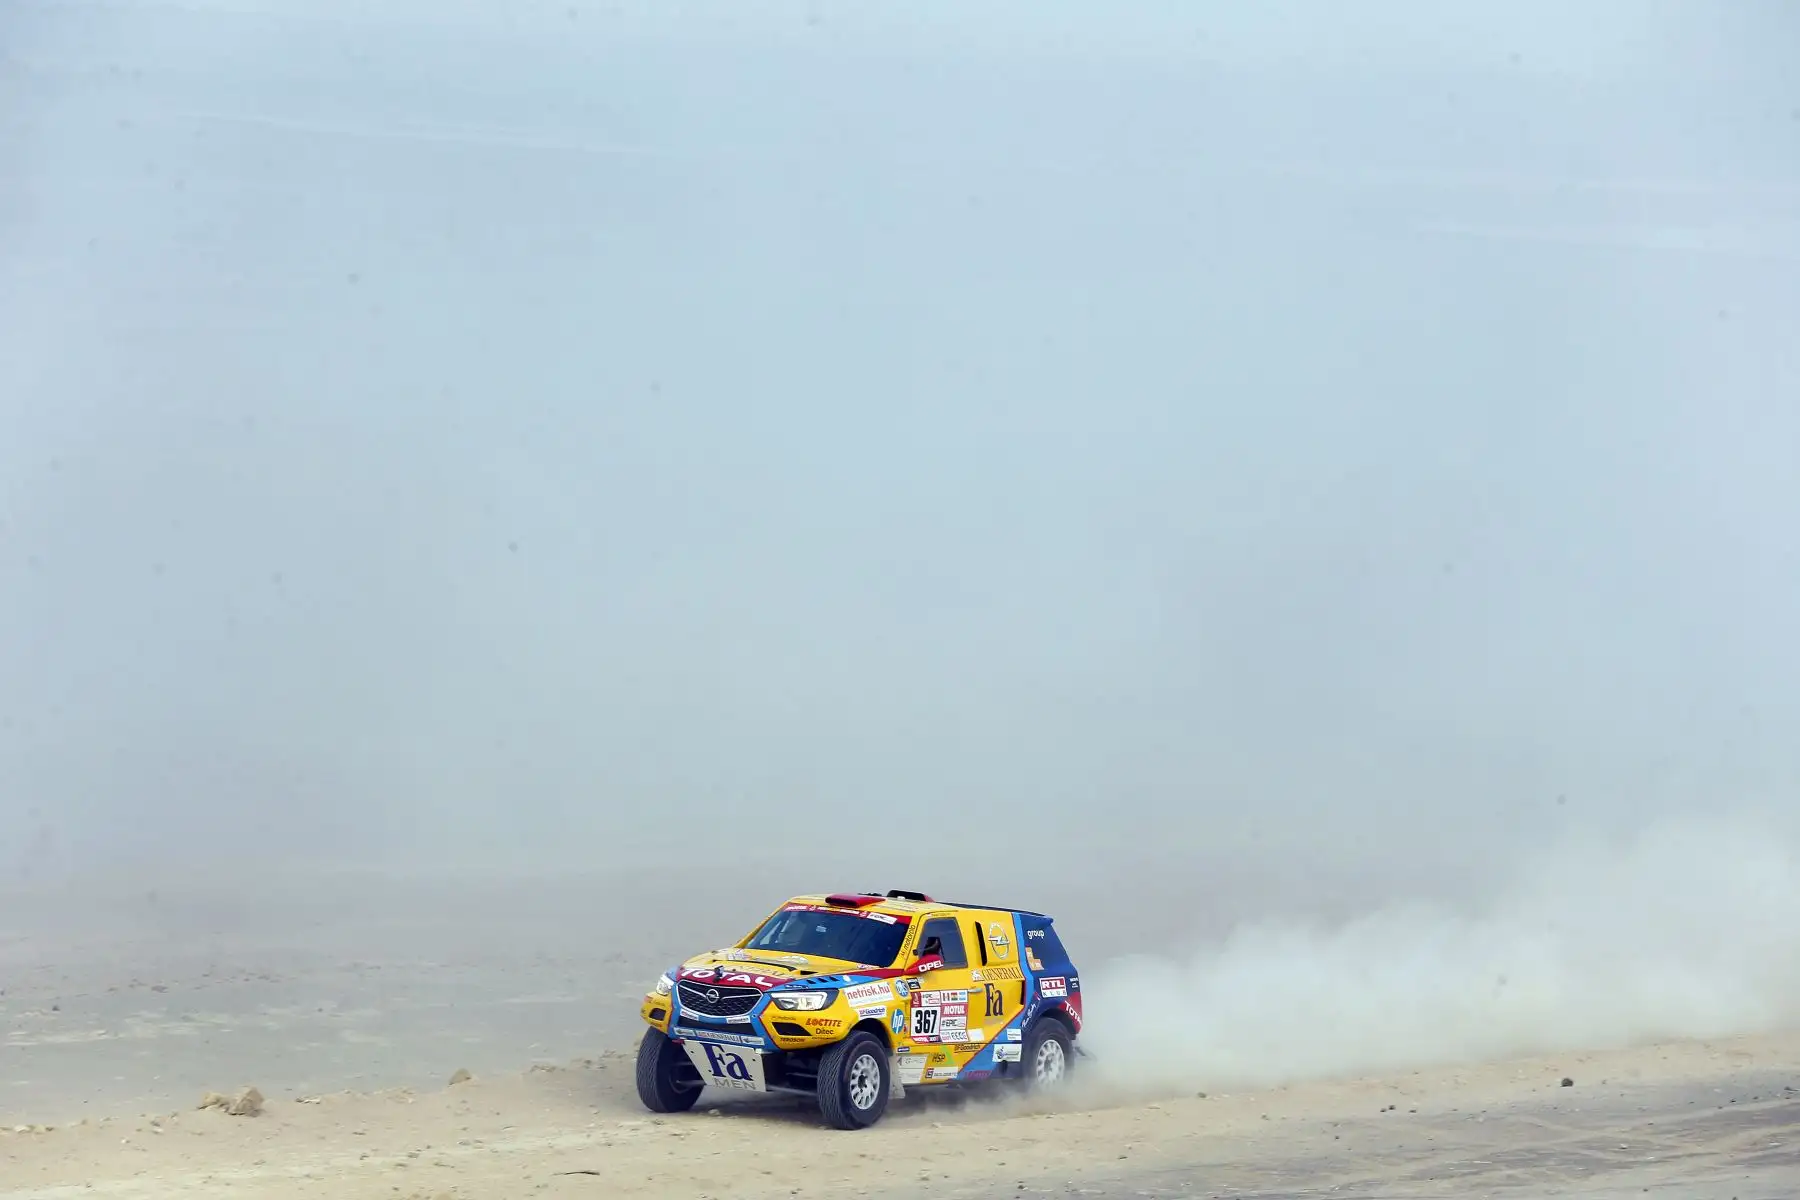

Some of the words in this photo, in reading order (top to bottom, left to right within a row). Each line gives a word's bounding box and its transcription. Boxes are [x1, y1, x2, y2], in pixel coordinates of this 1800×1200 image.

[1027, 930, 1045, 939] group
[918, 960, 943, 972] OPEL
[681, 969, 773, 987] TOTAL
[982, 967, 1024, 981] GENERALI
[1041, 980, 1065, 988] RTL
[847, 983, 890, 1000] netrisk.hu
[984, 983, 1003, 1017] Fa
[944, 1005, 965, 1014] MOTUL
[806, 1018, 842, 1027] LOCTITE
[892, 1009, 904, 1034] hp
[915, 1010, 937, 1033] 367
[700, 1042, 753, 1081] Fa
[714, 1078, 757, 1090] MEN
